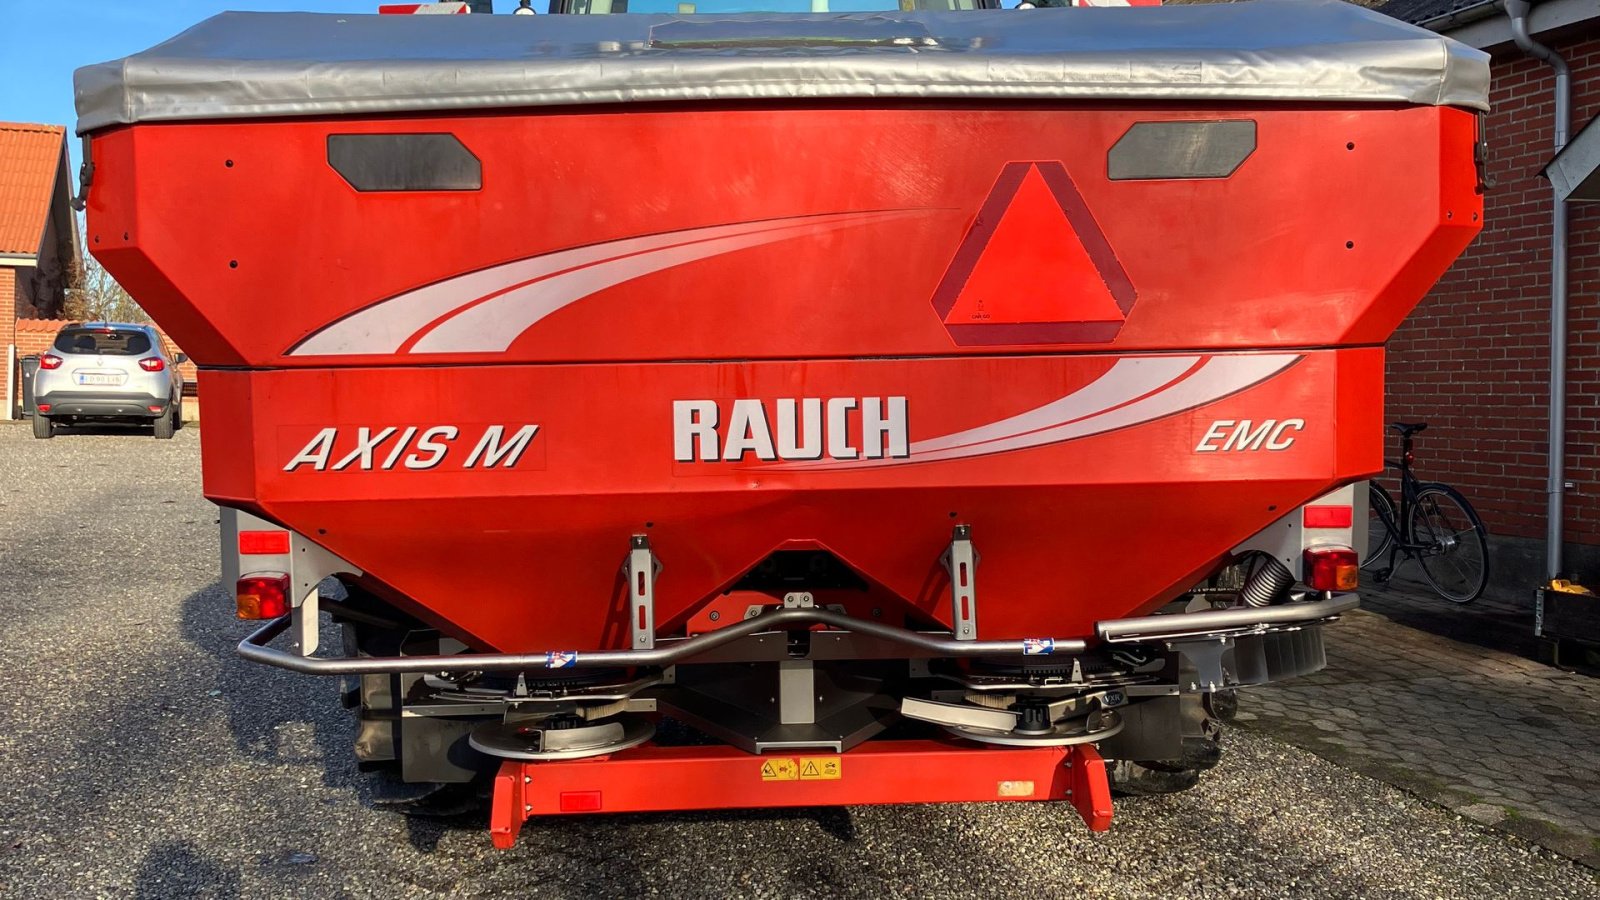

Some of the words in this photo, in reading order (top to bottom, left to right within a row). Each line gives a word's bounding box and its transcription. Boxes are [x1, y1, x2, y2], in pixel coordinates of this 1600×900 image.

[282, 425, 459, 472] AXIS
[462, 424, 540, 469] M
[673, 396, 910, 462] RAUCH
[1194, 418, 1306, 453] EMC
